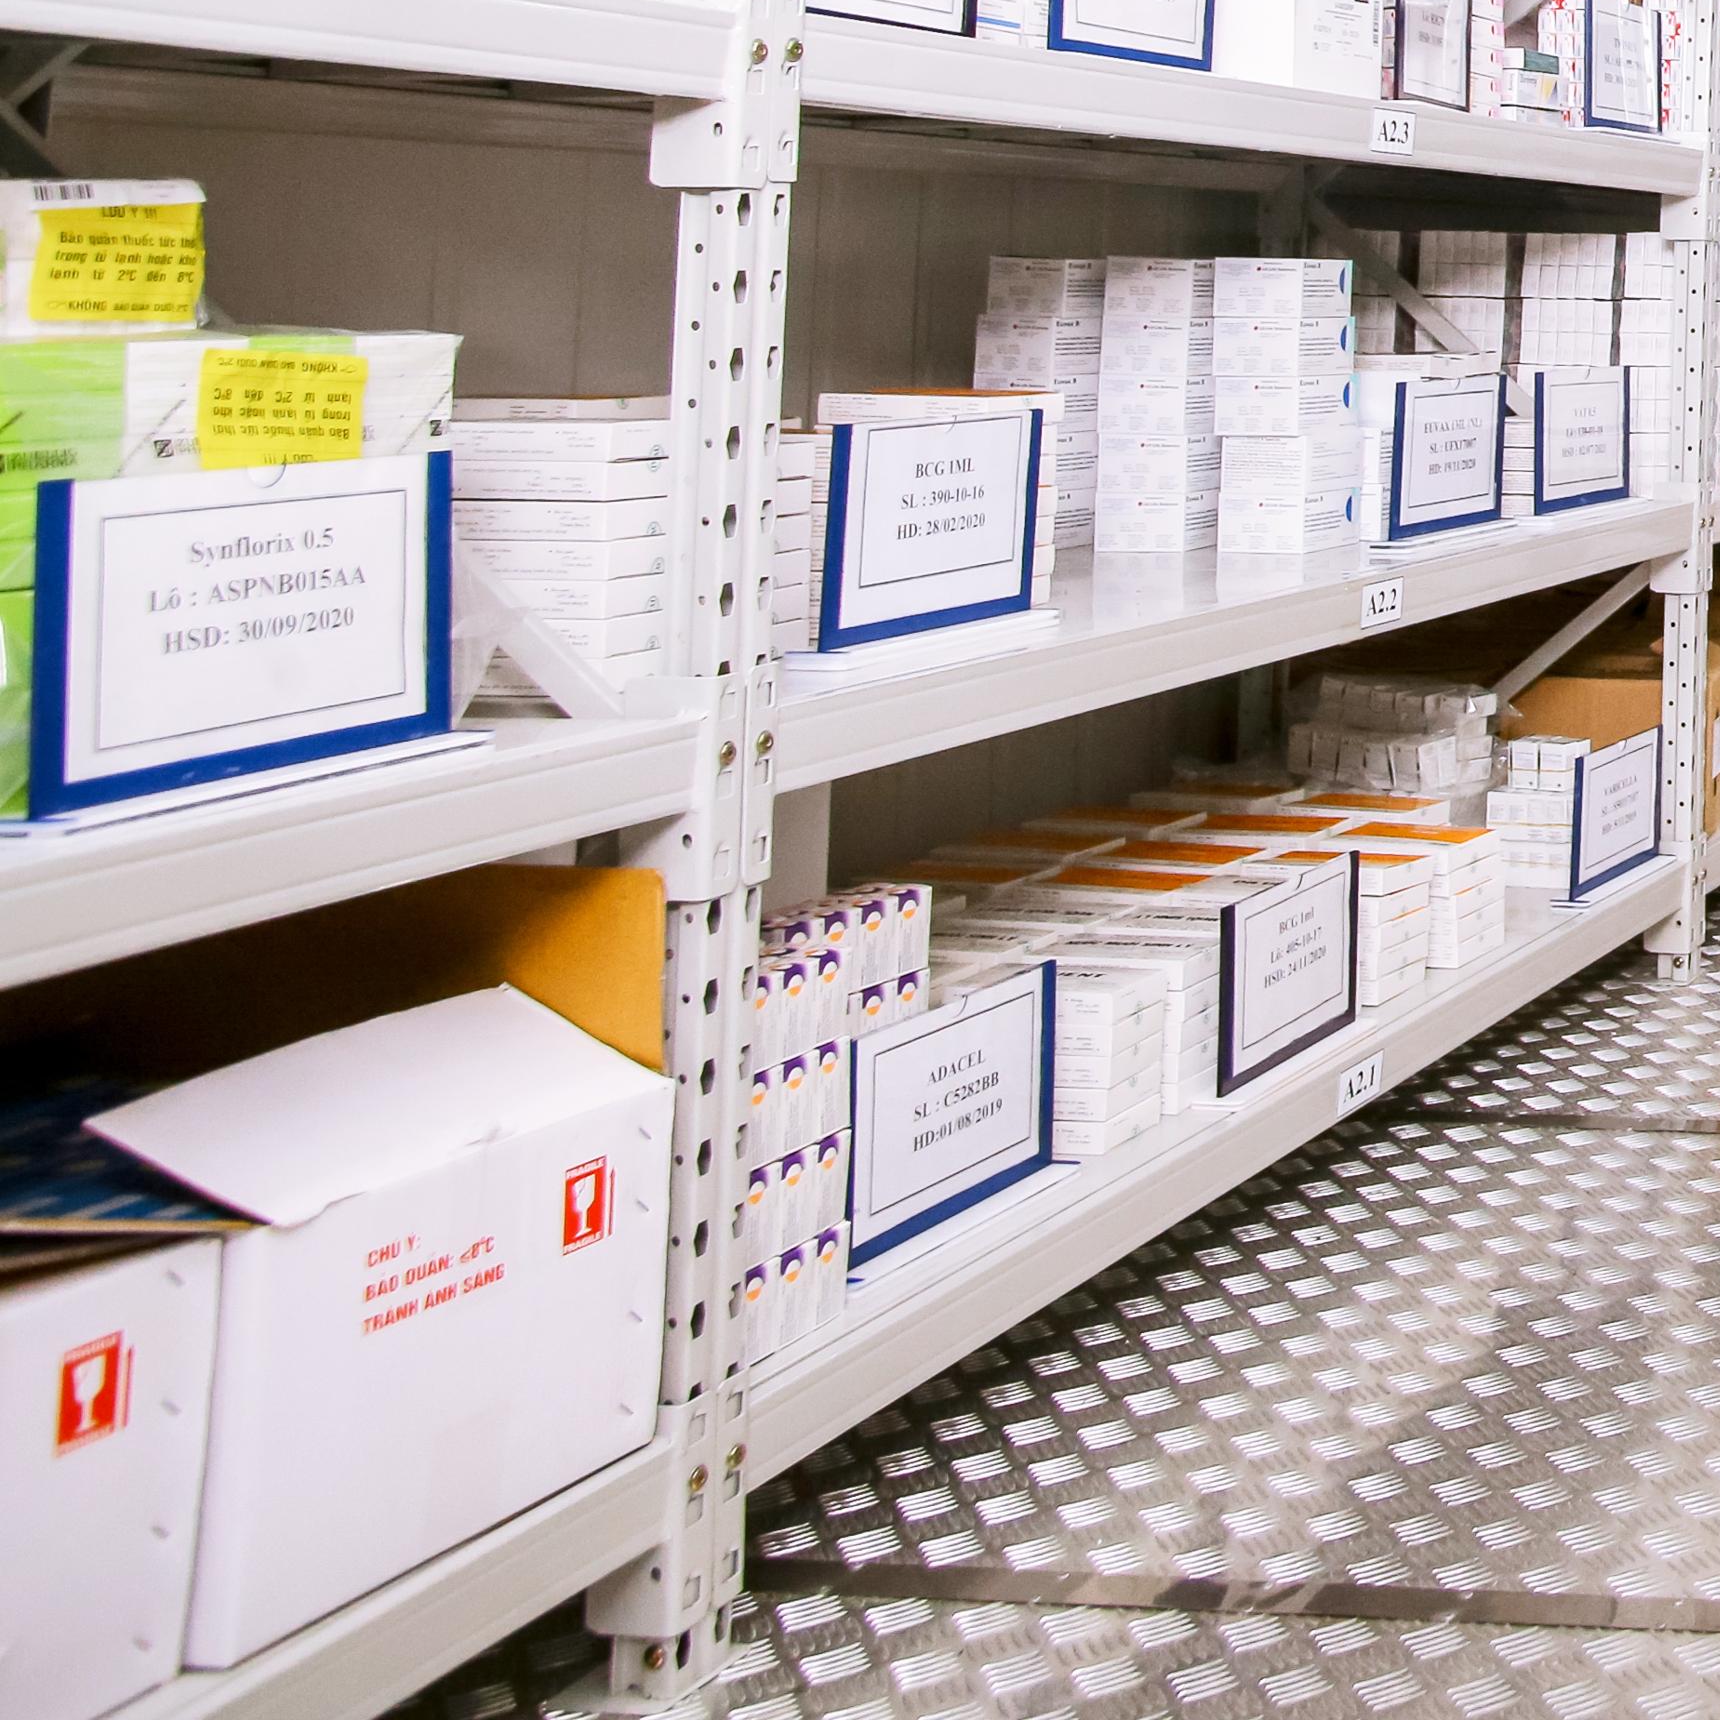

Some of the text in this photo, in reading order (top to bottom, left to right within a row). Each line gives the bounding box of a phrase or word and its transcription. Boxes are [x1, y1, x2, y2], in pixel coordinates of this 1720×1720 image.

[1377, 120, 1410, 145] A2.3
[914, 457, 975, 479] BCG 1ML
[900, 485, 985, 510] SL 390-10-16
[896, 512, 986, 540] HD: 28/02/2020
[190, 527, 334, 567] Synflorix 0.5
[149, 565, 366, 613] Lô ASPNB015AA
[1366, 587, 1397, 617] A2.2
[163, 606, 355, 654] HSD: 30/09/2020
[1279, 914, 1298, 934] BCG
[926, 1049, 986, 1086] ADACEL
[1343, 1063, 1376, 1104] A2.1
[913, 1070, 1000, 1123] SL C5282BB
